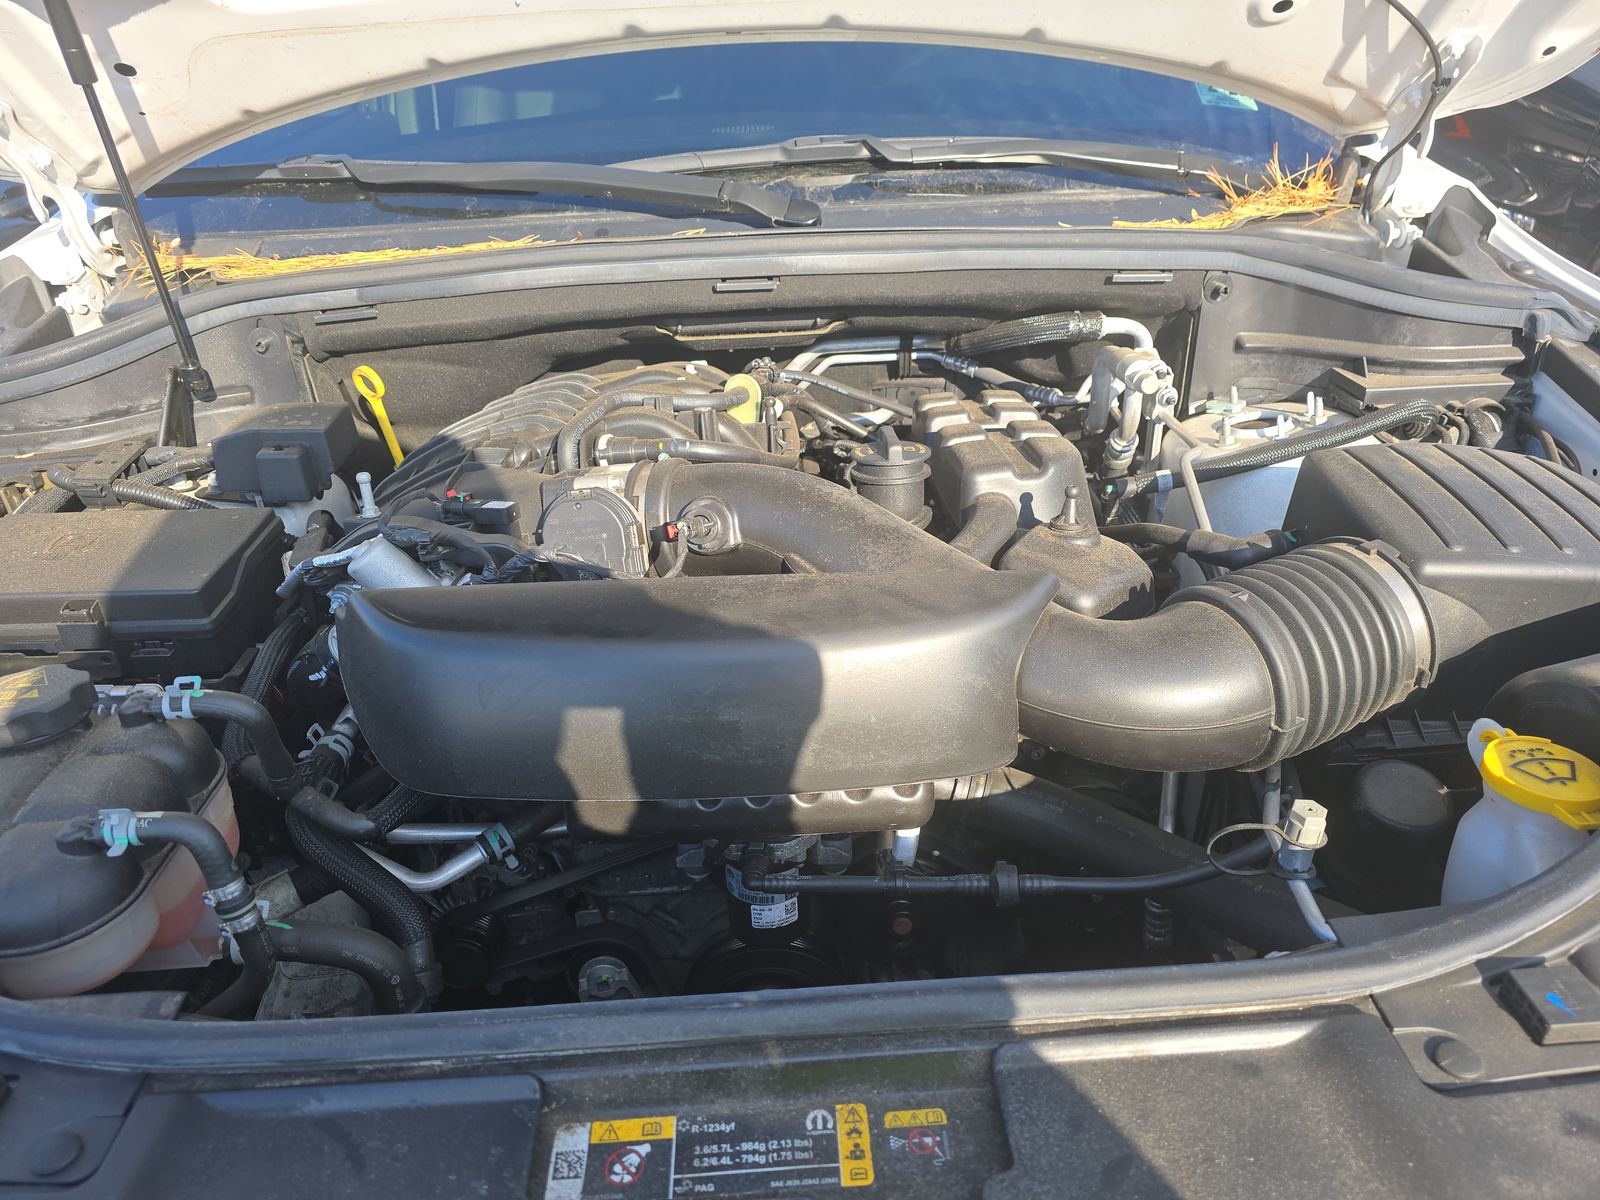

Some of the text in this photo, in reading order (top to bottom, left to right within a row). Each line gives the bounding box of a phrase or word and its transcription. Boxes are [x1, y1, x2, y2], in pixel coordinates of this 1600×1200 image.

[691, 1122, 736, 1133] R-1234yf
[694, 1143, 733, 1155] 3.6/5.7L
[768, 1139, 792, 1151] (2.13
[794, 1138, 813, 1148] lbs)
[693, 1156, 733, 1167] 6.2/6.4L
[741, 1154, 766, 1164] 794g
[768, 1152, 793, 1163] (1.75
[794, 1150, 813, 1160] lbs)
[694, 1183, 715, 1192] PAG
